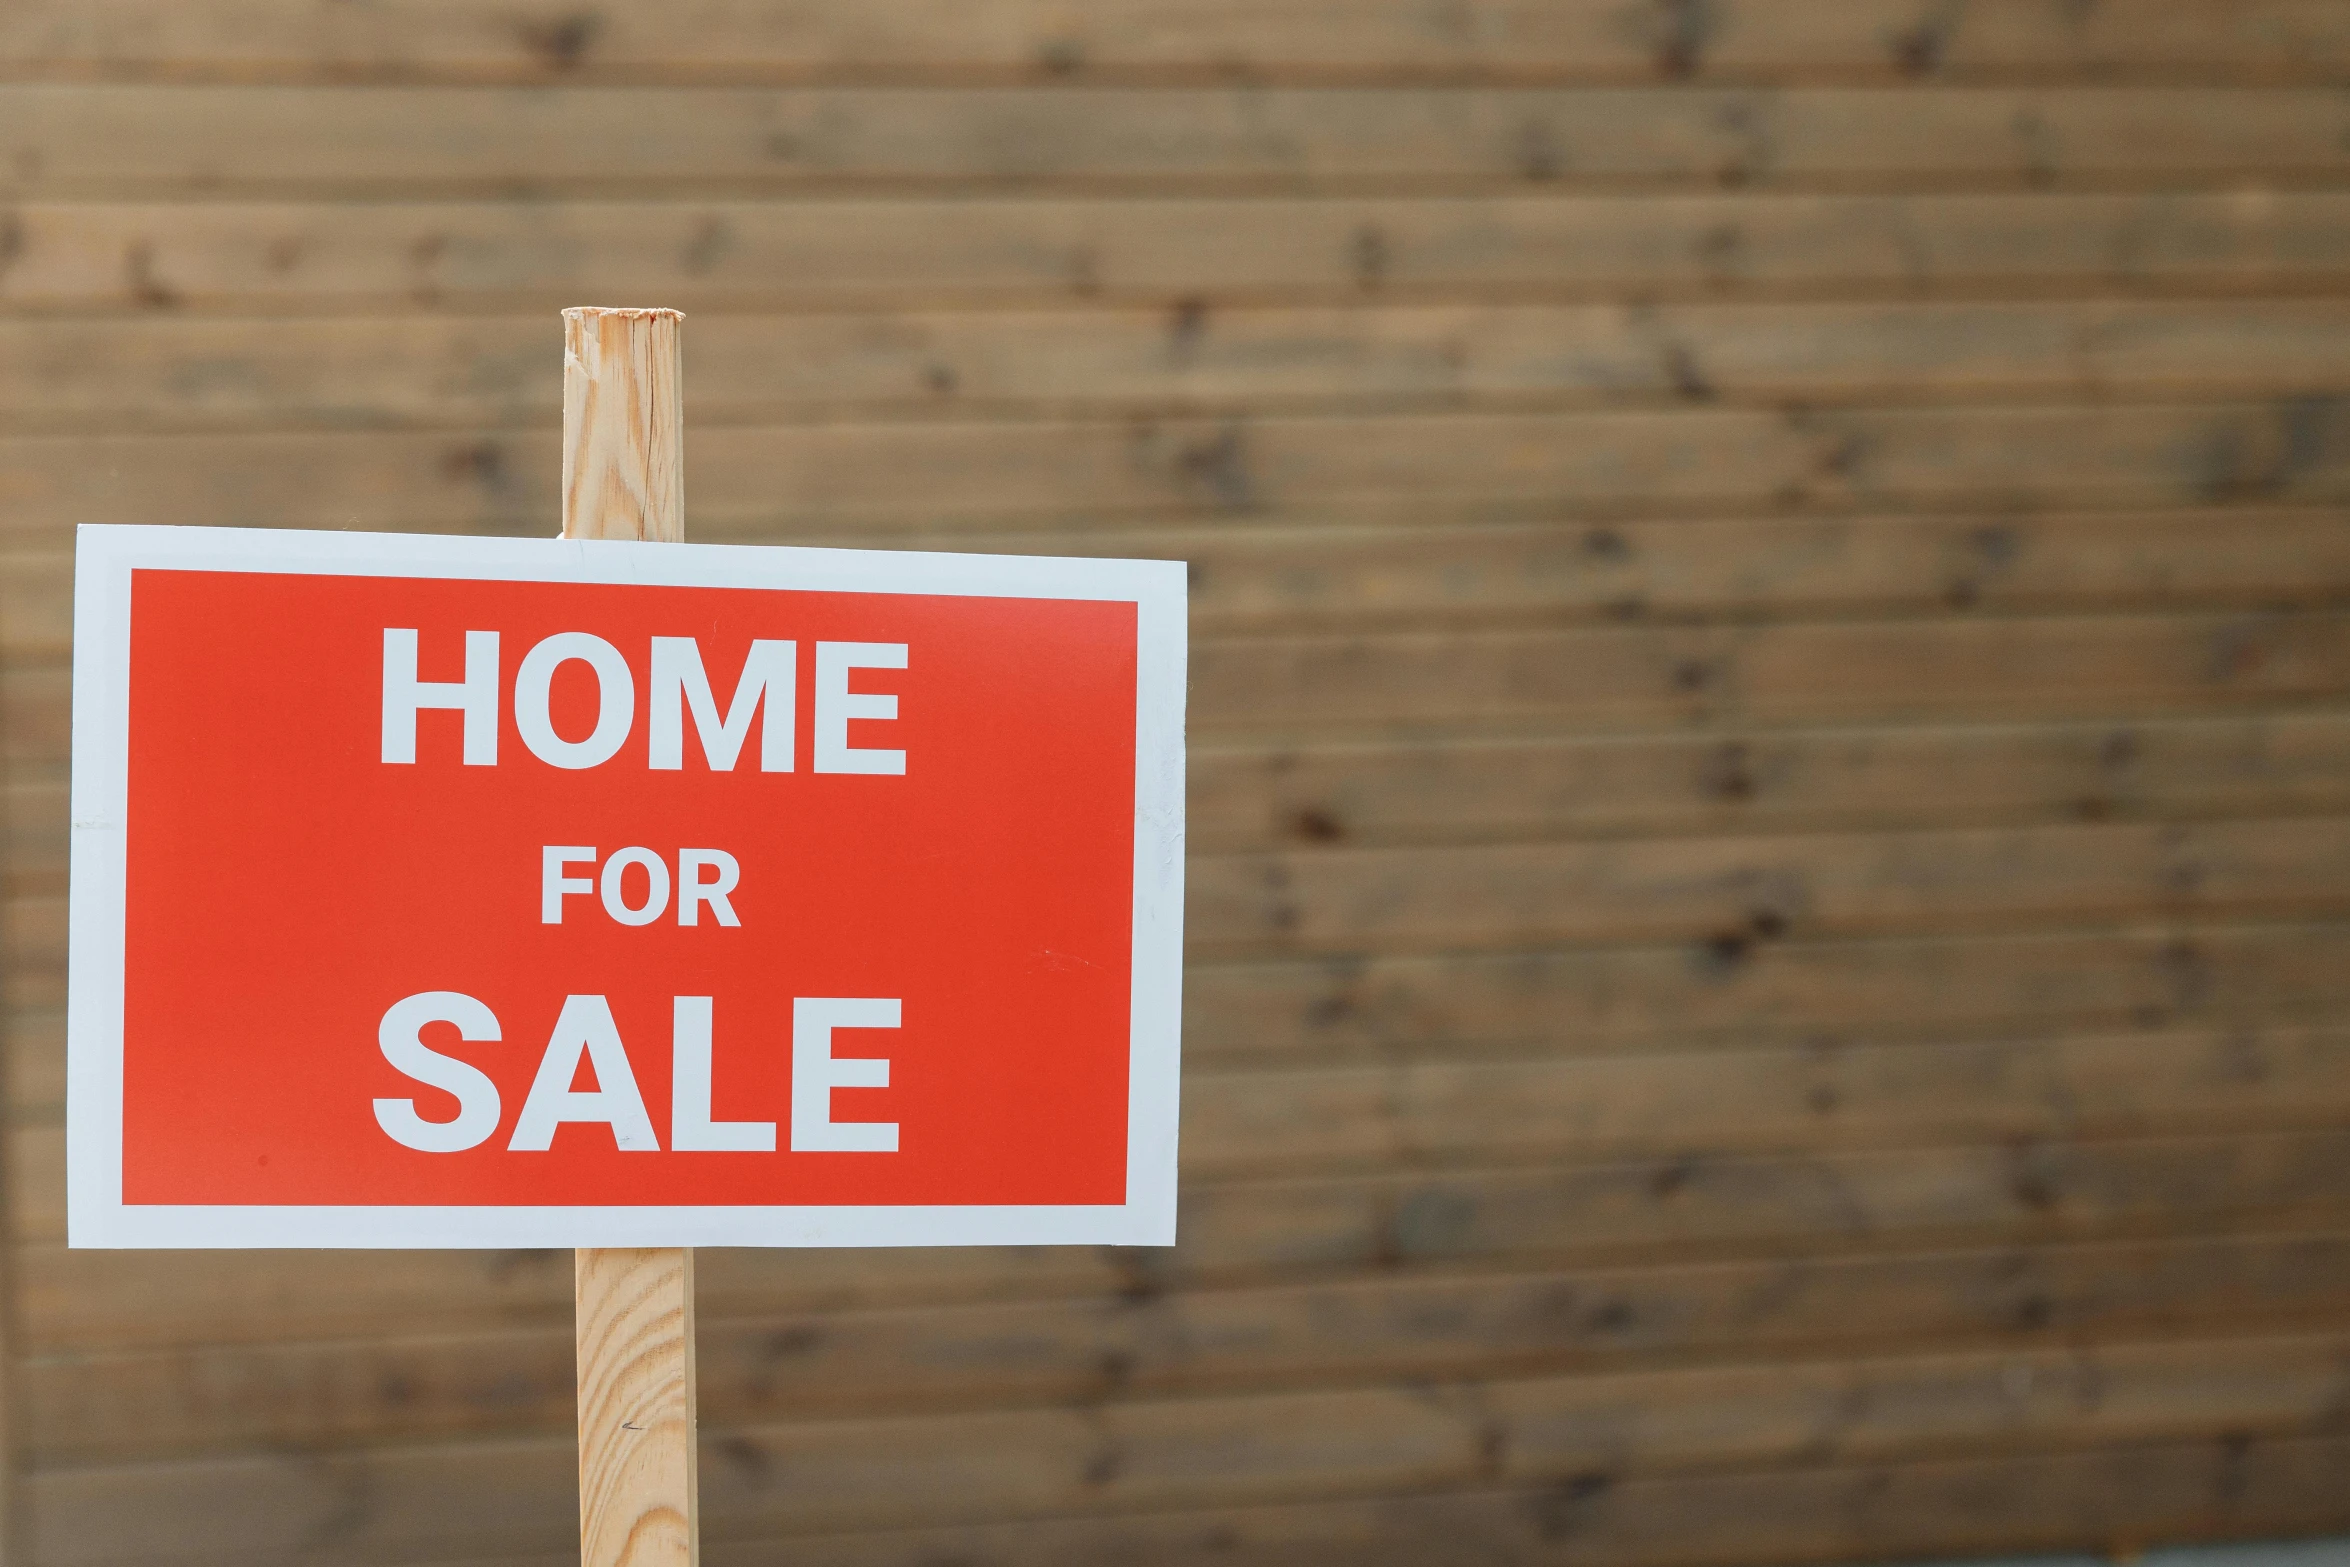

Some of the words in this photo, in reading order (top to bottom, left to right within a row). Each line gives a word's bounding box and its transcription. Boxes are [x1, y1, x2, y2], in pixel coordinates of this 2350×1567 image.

[381, 627, 909, 776] HOME
[541, 845, 742, 927] FOR
[372, 990, 902, 1153] SALE
